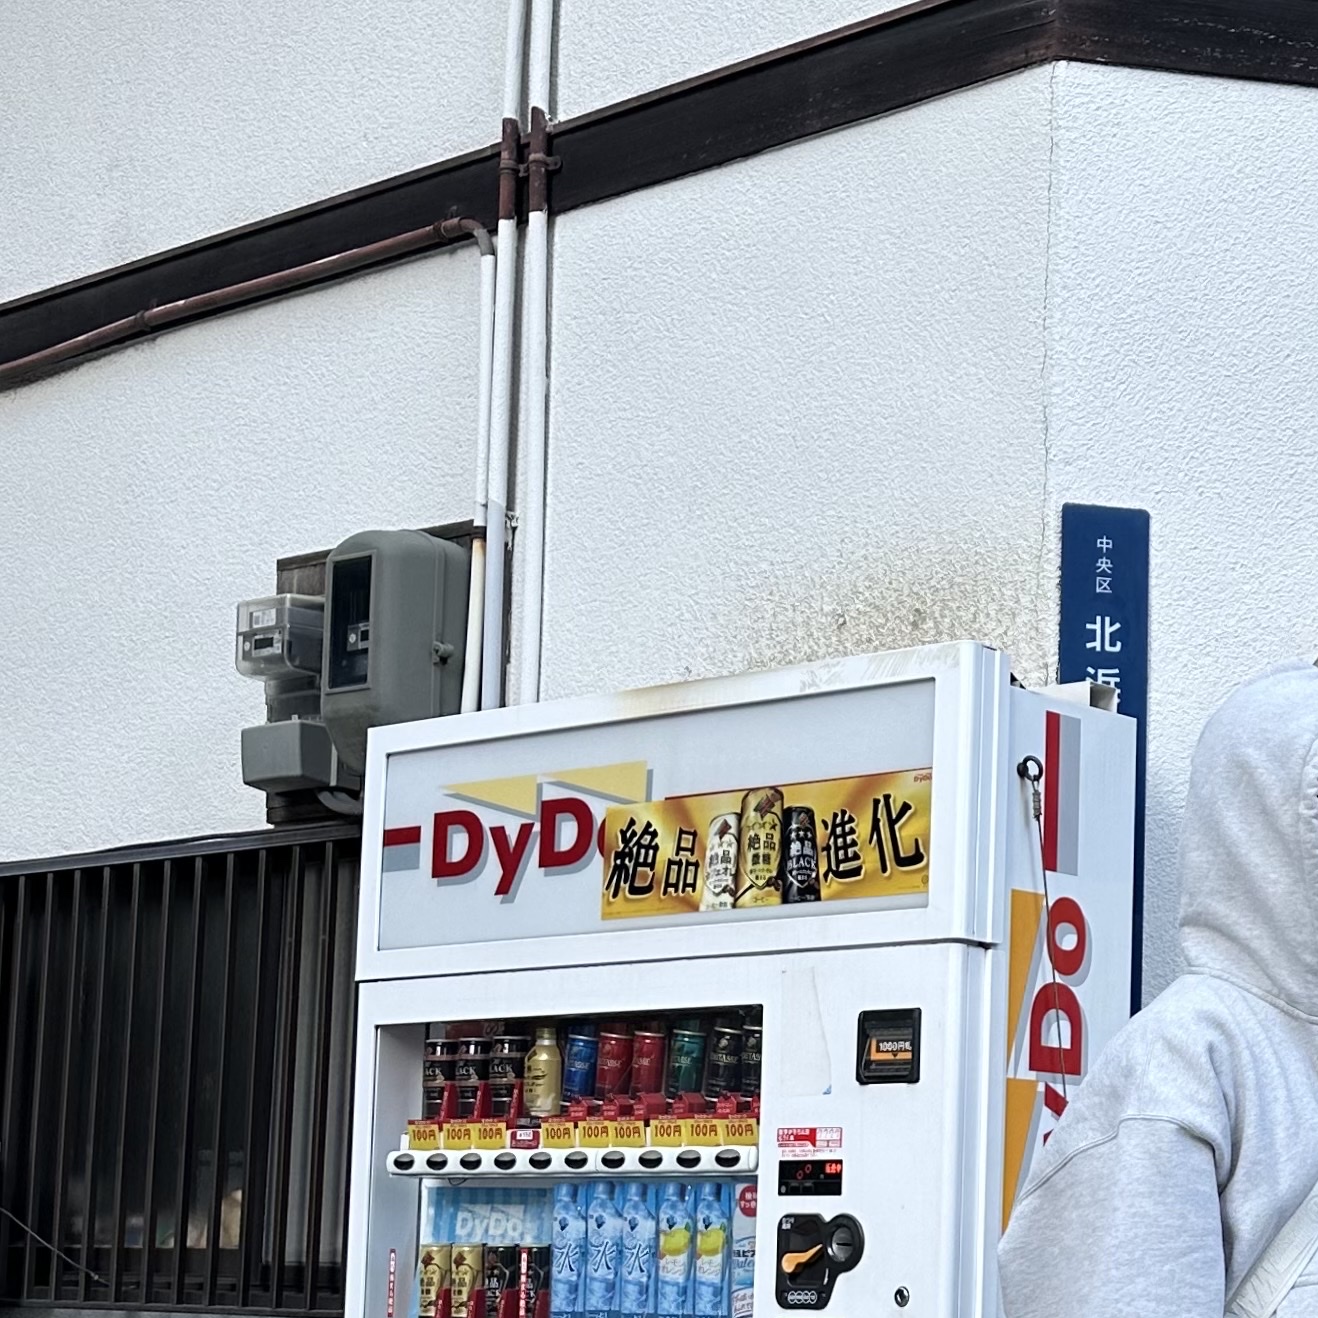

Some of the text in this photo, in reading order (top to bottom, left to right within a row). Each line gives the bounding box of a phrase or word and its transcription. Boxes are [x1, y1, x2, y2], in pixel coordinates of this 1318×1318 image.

[1096, 535, 1113, 593] 中央区
[431, 797, 606, 895] DyD
[604, 793, 925, 899] 絶品 進化
[748, 832, 776, 851] 絶品
[786, 855, 817, 870] BLACK
[456, 1211, 524, 1239] DyDo
[554, 1243, 580, 1274] 水
[587, 1240, 616, 1273] 水
[622, 1241, 650, 1275] 水
